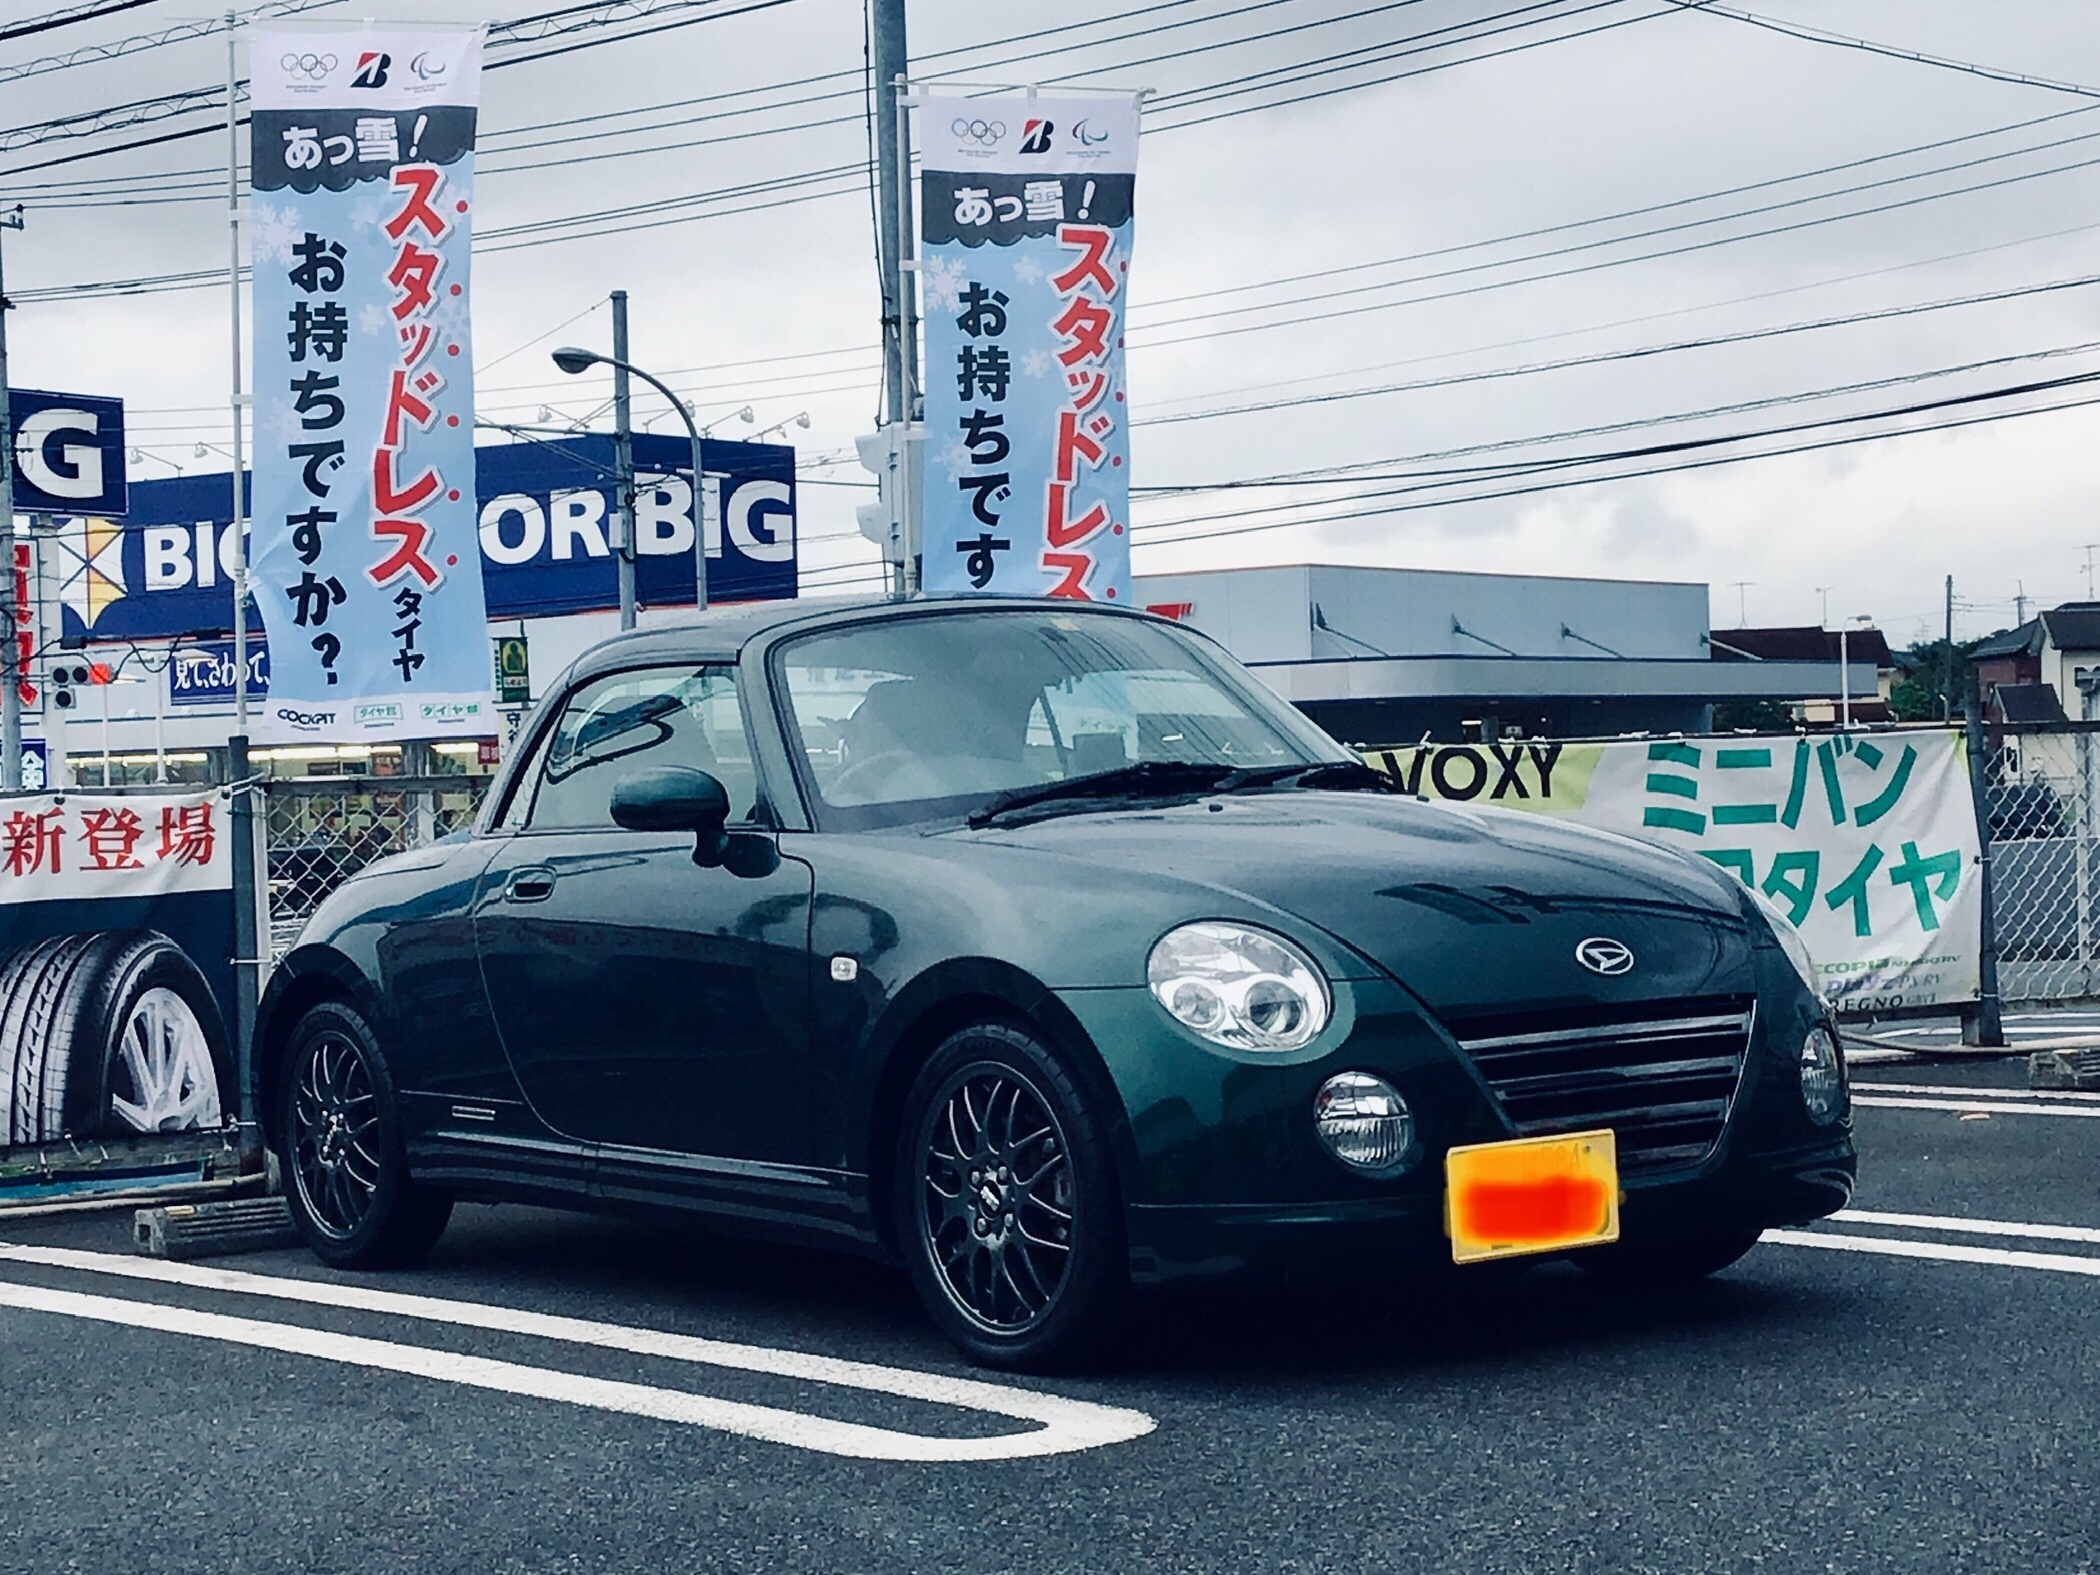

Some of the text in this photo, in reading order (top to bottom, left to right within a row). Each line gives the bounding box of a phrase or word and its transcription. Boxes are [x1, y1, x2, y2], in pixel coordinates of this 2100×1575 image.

[285, 232, 348, 685] お持ちですか？
[956, 281, 1011, 589] お持ちです
[633, 471, 794, 562] BIG
[277, 708, 336, 725] COCKPIT
[1380, 744, 1563, 801] VOXY
[1643, 735, 1918, 837] ミニバン
[1, 802, 216, 877] 新登場
